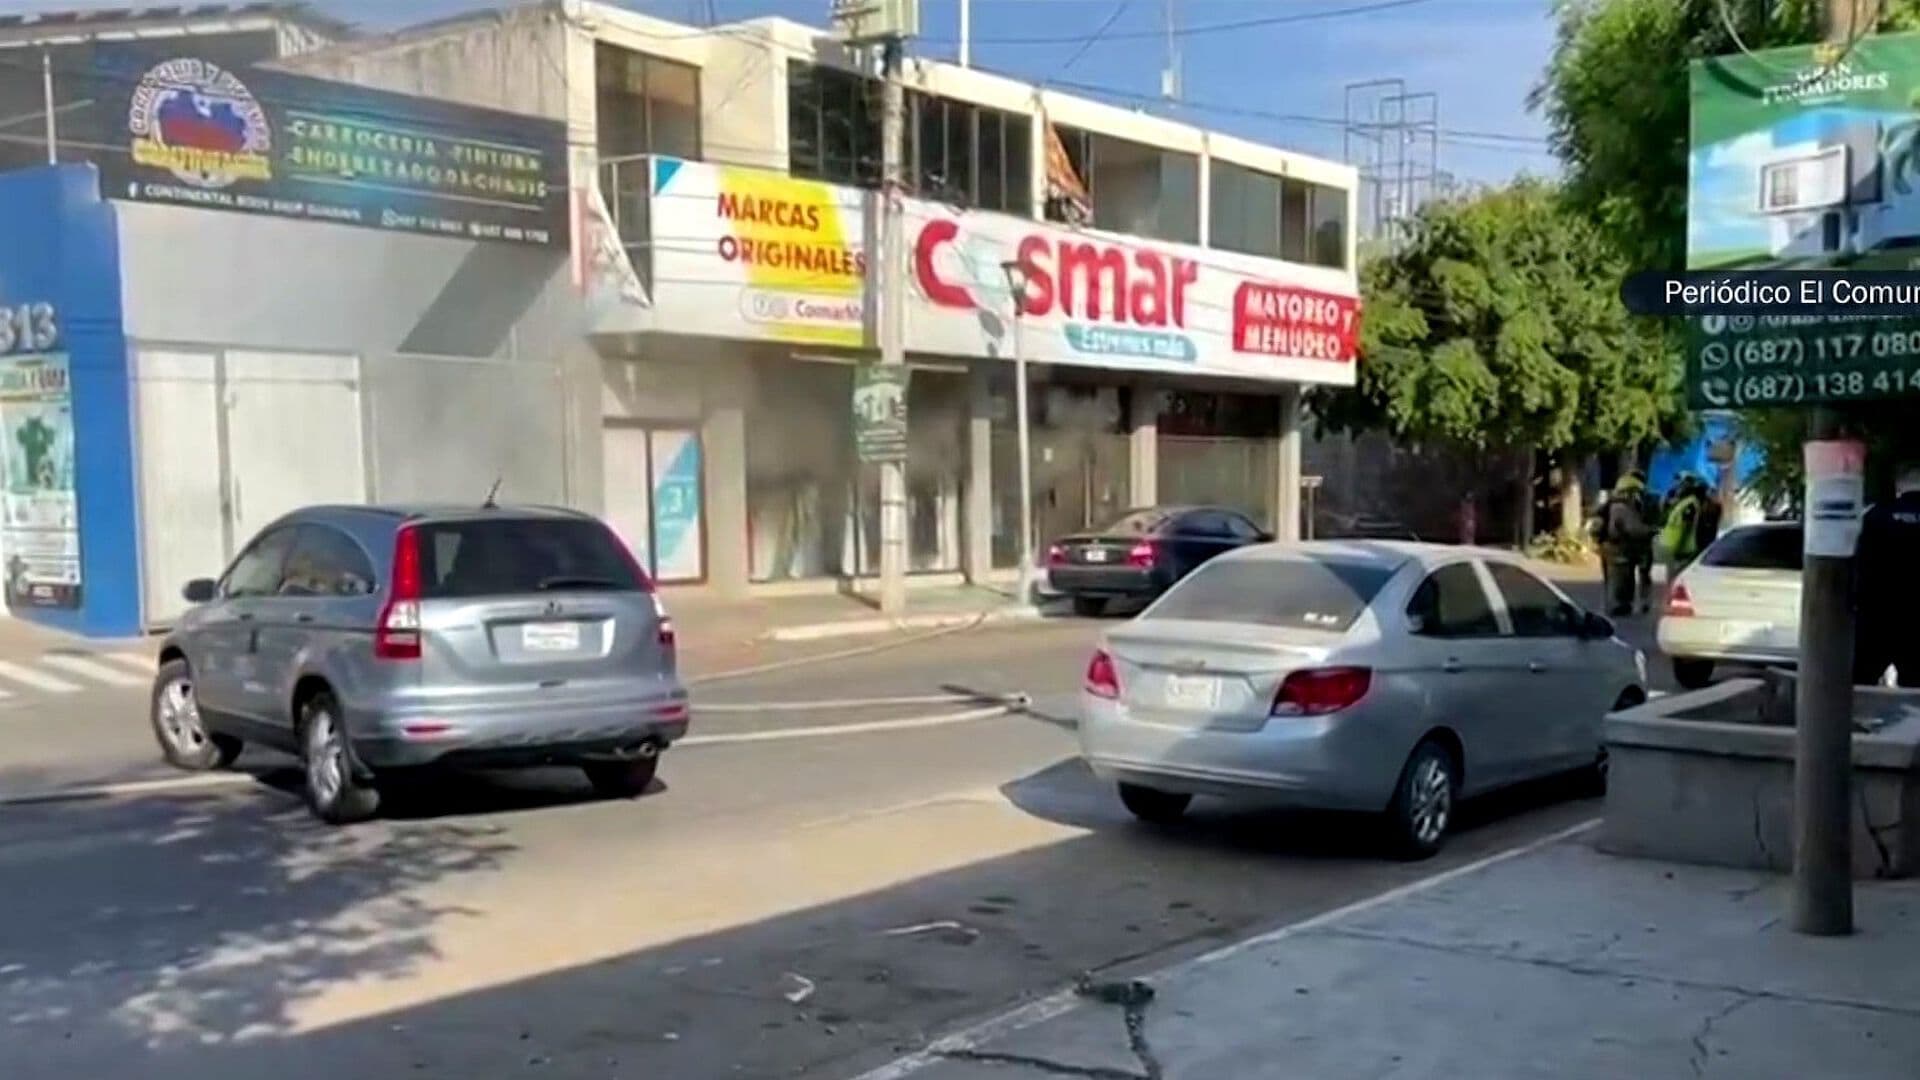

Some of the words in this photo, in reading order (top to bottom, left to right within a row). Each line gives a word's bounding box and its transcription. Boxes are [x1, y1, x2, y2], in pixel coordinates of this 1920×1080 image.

[718, 192, 820, 233] MARCAS
[718, 235, 866, 277] ORIGINALES
[914, 219, 1198, 329] Csmar
[1244, 287, 1339, 327] MAYOREO
[1244, 324, 1341, 359] MENUDEO
[1733, 337, 1804, 371] (687)
[1814, 335, 1864, 360] 117
[1733, 374, 1804, 405] (687)
[1814, 371, 1864, 396] 138
